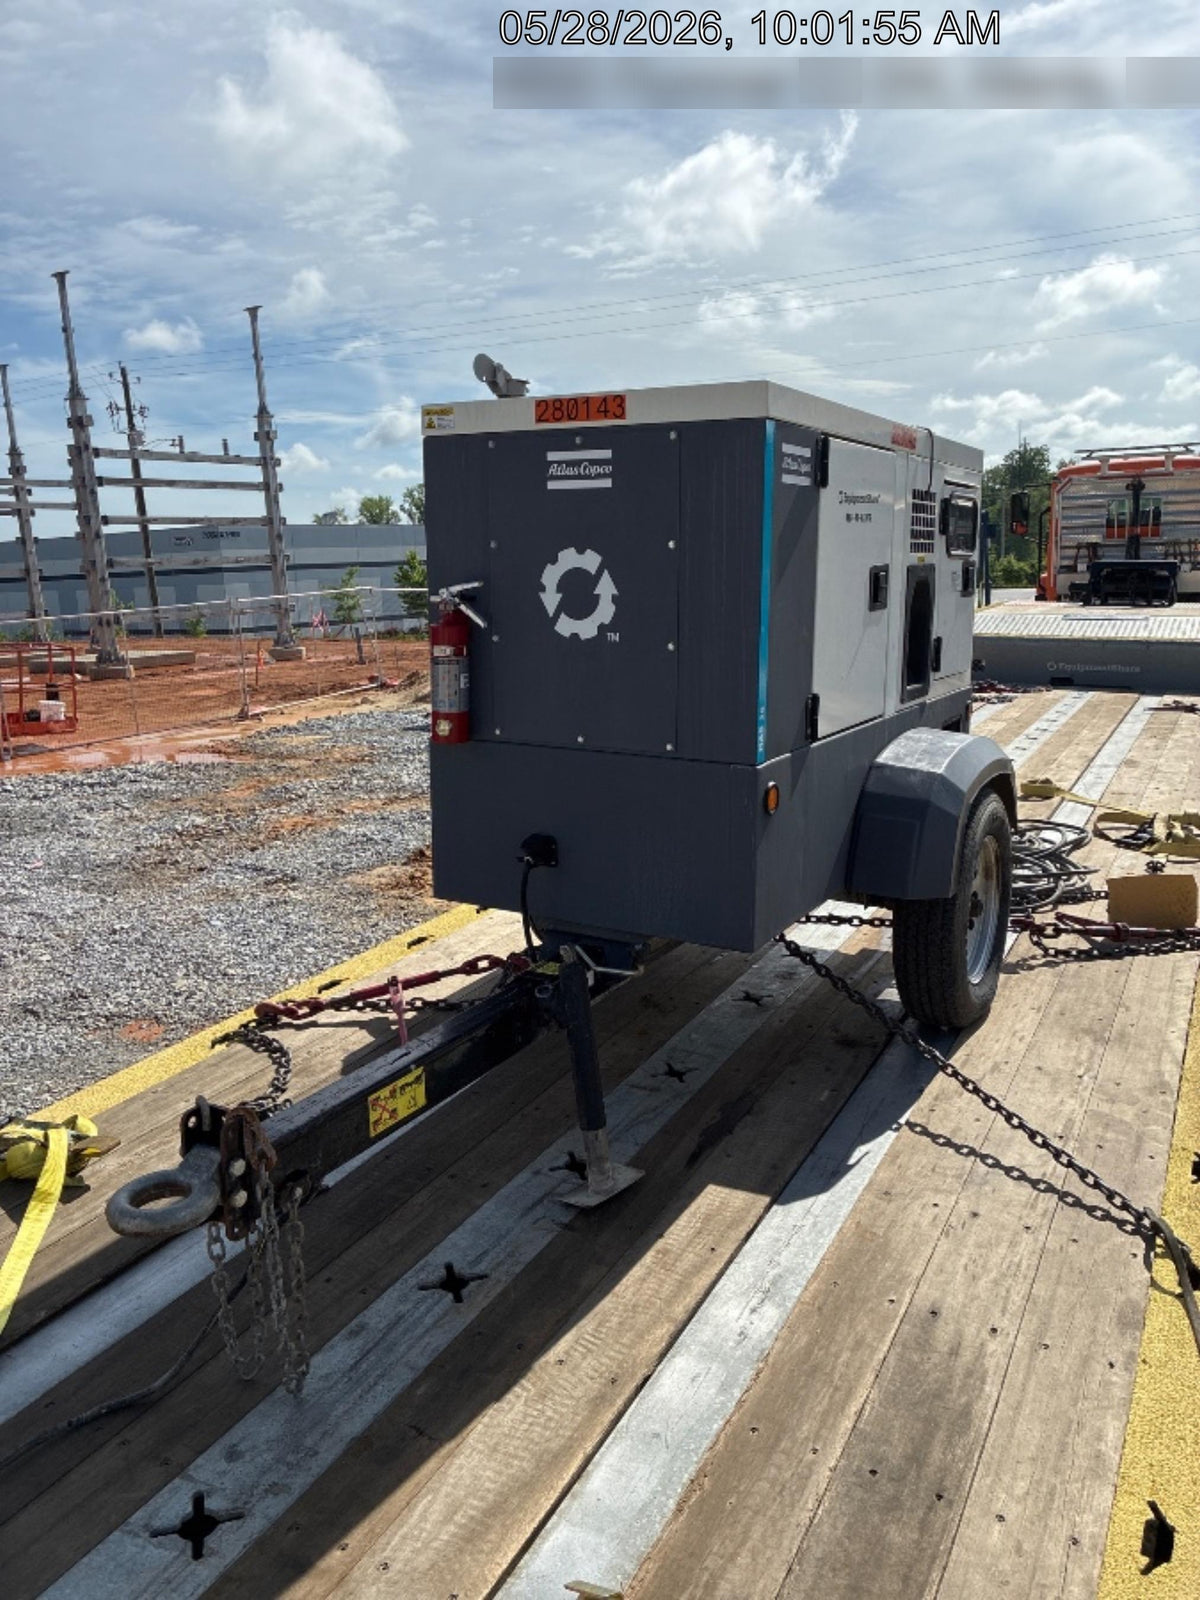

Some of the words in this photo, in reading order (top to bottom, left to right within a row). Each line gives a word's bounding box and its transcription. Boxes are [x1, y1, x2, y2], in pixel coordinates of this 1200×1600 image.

[536, 395, 626, 422] 280143
[547, 463, 579, 477] Atlas
[579, 461, 613, 477] Copco
